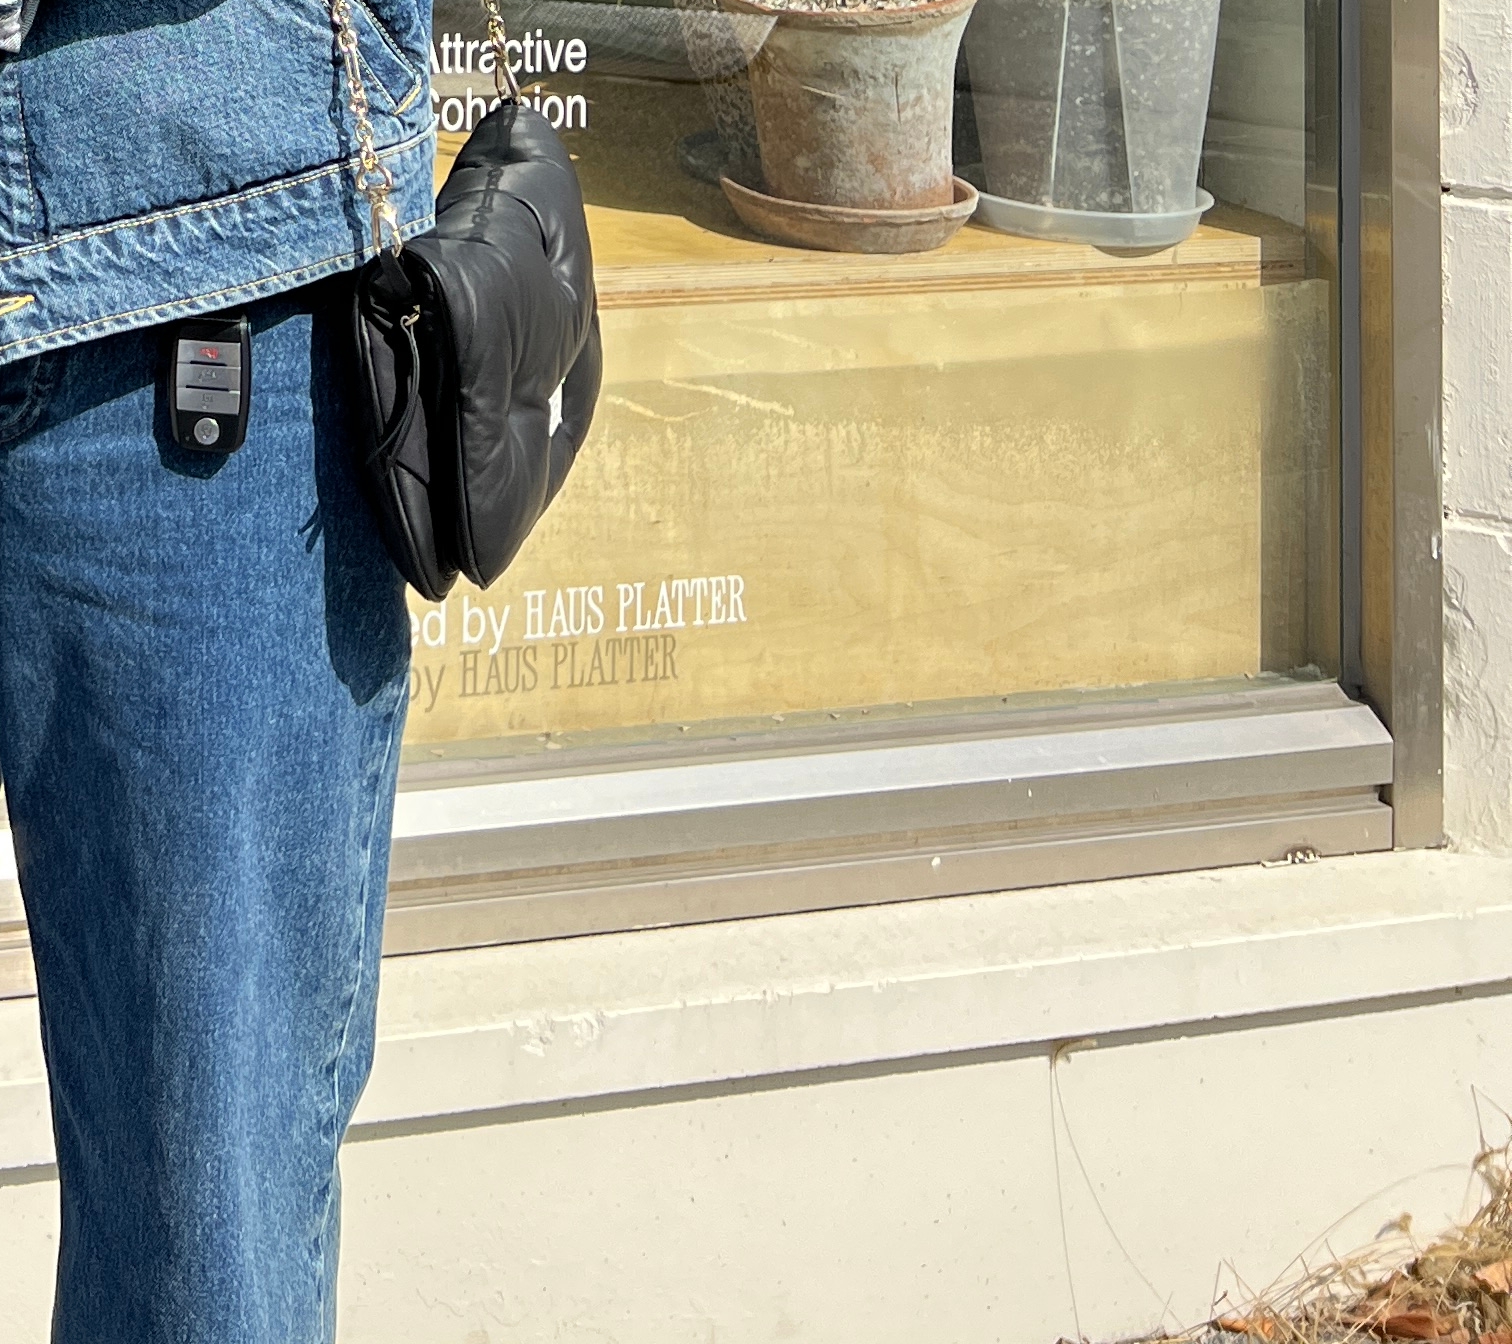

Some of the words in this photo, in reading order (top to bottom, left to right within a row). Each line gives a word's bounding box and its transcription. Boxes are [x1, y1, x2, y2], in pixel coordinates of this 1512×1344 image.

[462, 596, 510, 656] by
[524, 586, 605, 640] HAUS
[616, 574, 748, 632] PLATTER
[550, 633, 679, 690] PLATTER
